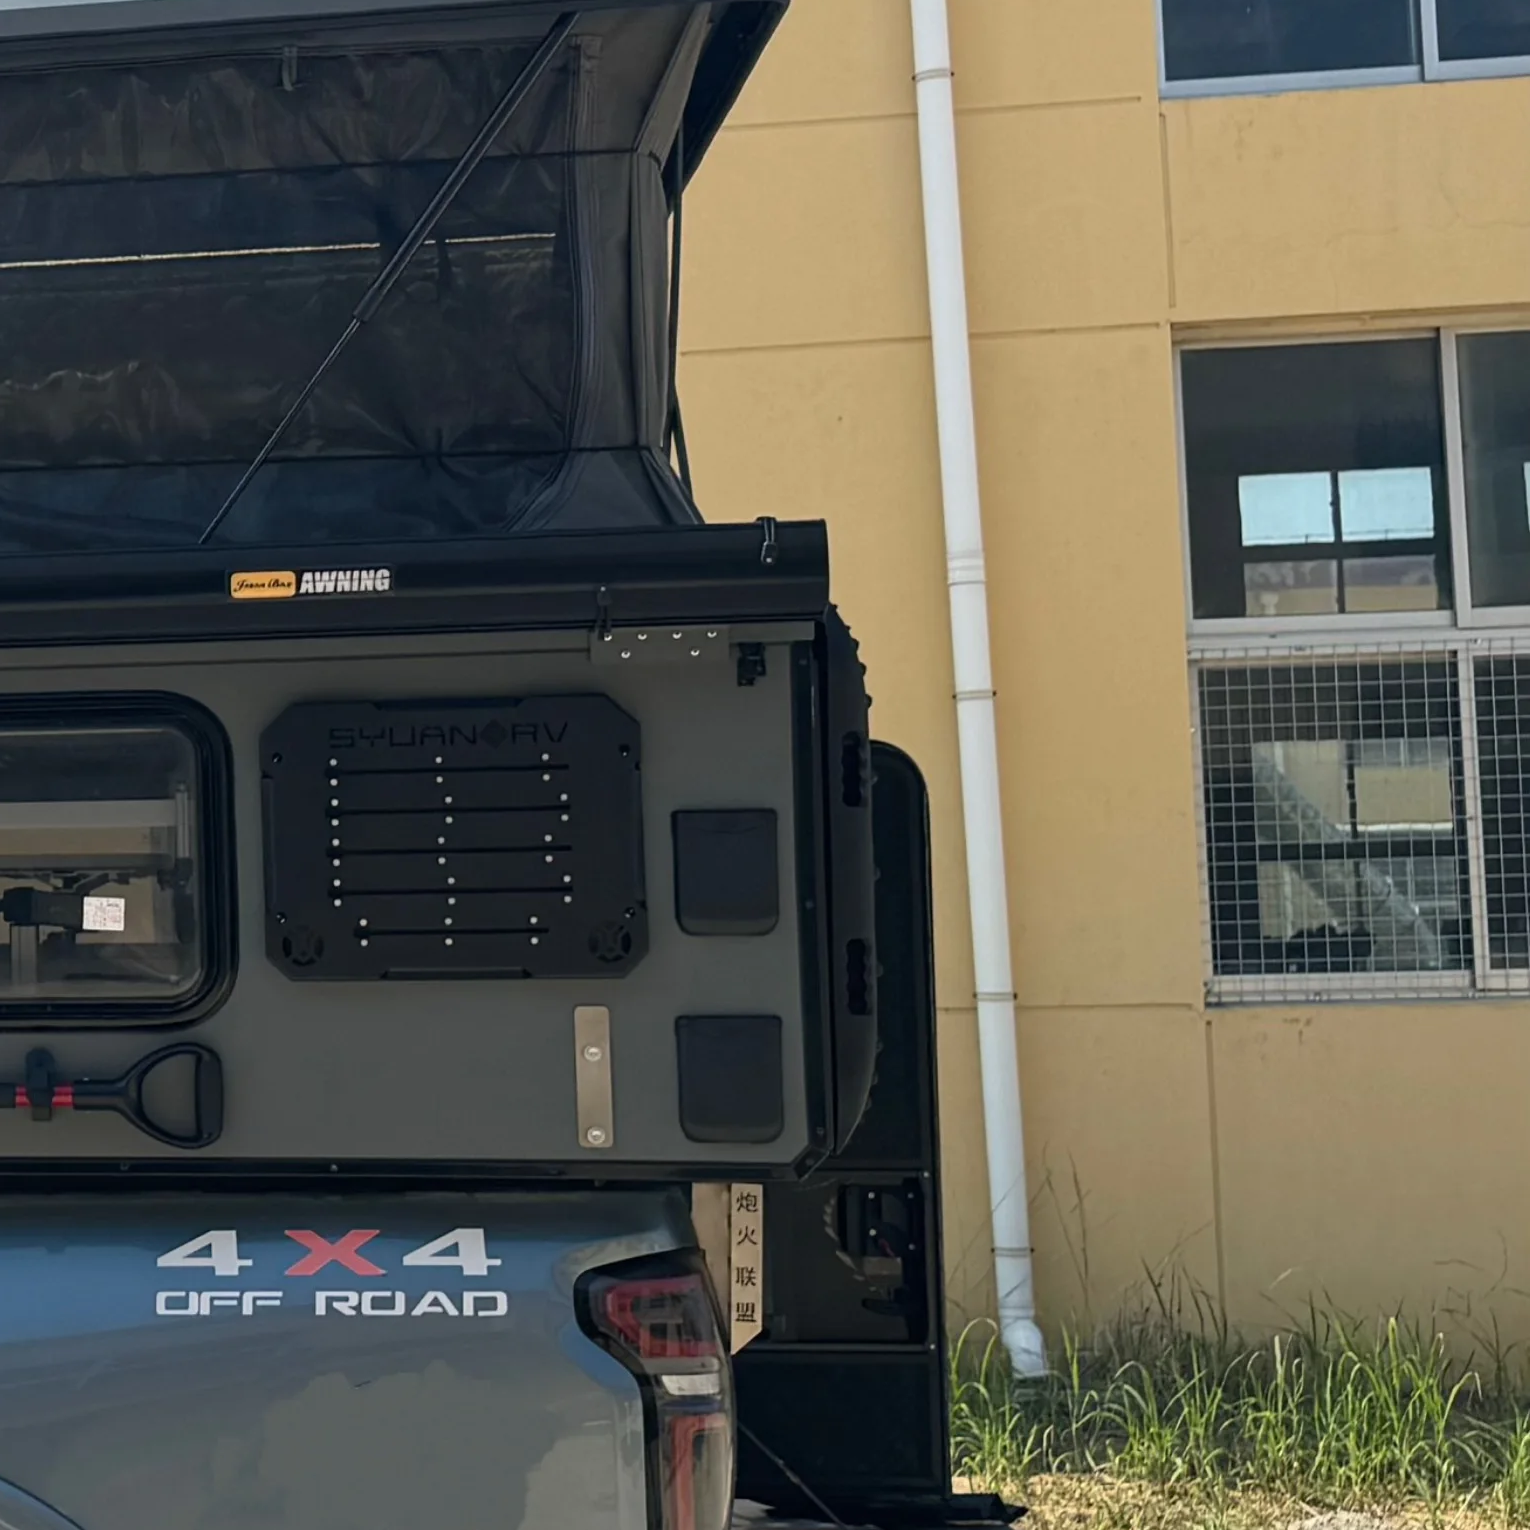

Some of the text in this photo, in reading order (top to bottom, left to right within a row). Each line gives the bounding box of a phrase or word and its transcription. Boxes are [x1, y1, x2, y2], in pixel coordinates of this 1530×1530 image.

[299, 568, 391, 594] AWNING
[328, 722, 478, 748] SYUAN
[735, 1191, 759, 1323] 炮火联盟
[155, 1290, 509, 1317] OFF ROAD
